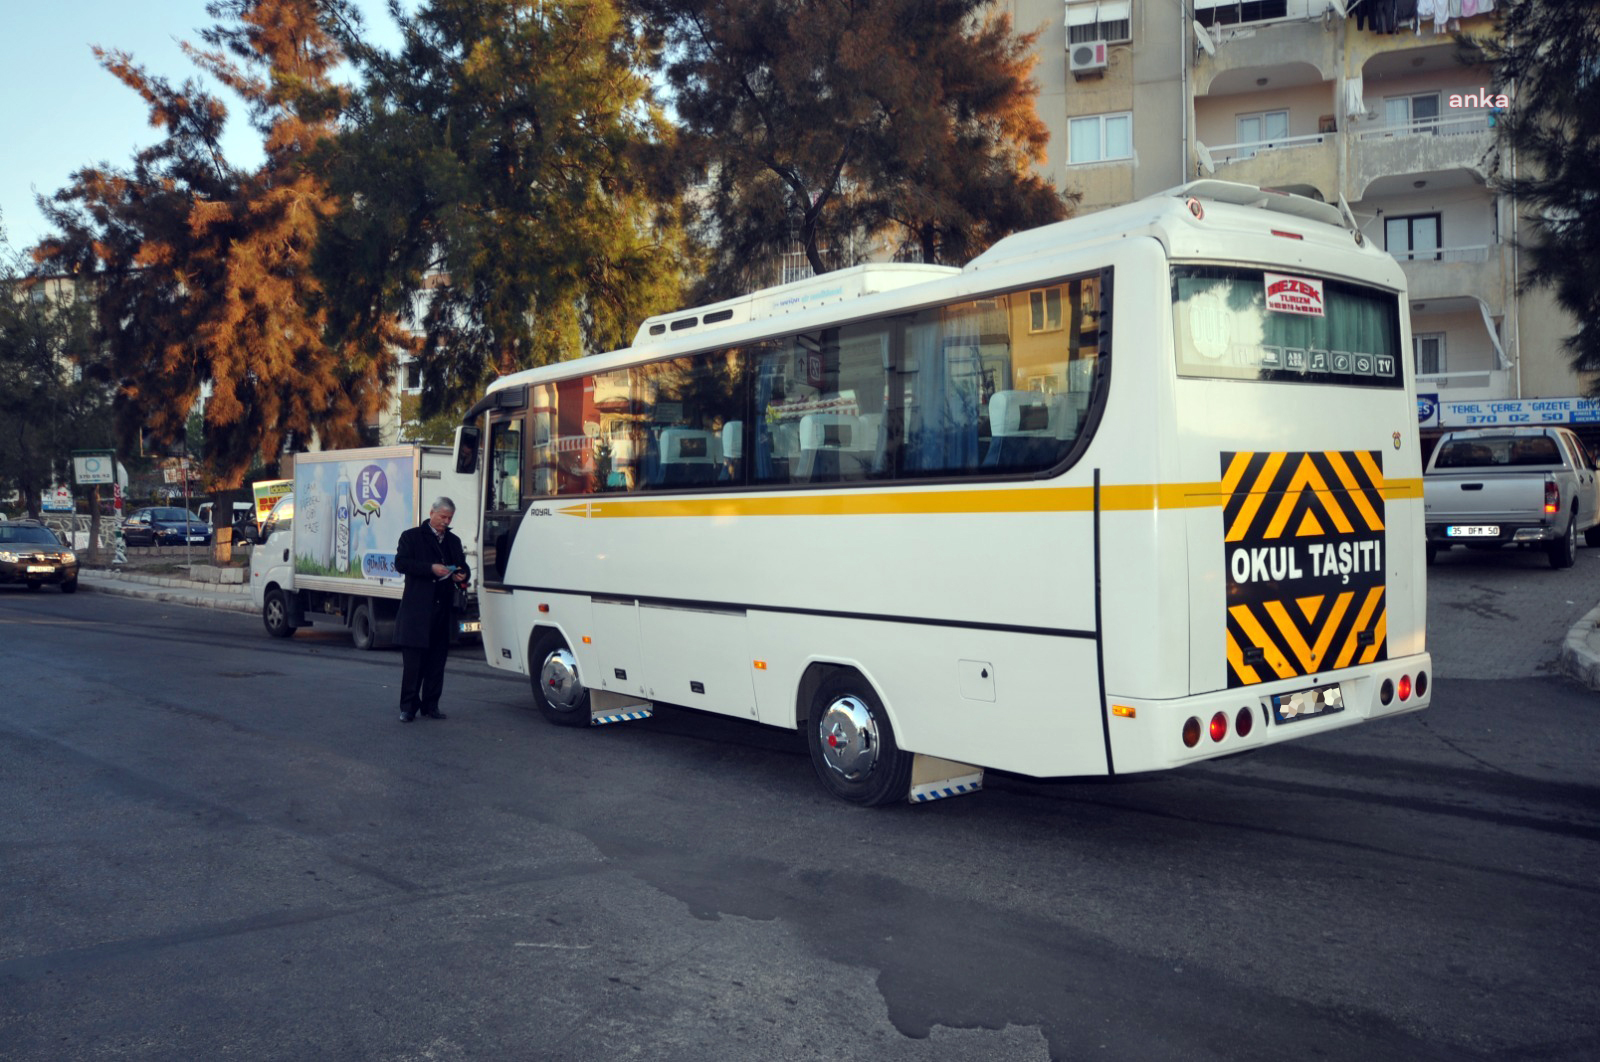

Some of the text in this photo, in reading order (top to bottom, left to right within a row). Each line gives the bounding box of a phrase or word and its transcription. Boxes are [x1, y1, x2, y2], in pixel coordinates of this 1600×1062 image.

[1378, 360, 1391, 373] TV
[1532, 401, 1570, 411] GAZETE
[1466, 415, 1497, 424] 370
[1509, 414, 1530, 422] 02
[1542, 412, 1563, 421] 50
[531, 508, 552, 516] ROYAL
[1452, 527, 1462, 535] 35
[1488, 527, 1499, 535] 50
[1231, 540, 1381, 585] OKUL TAŞITI
